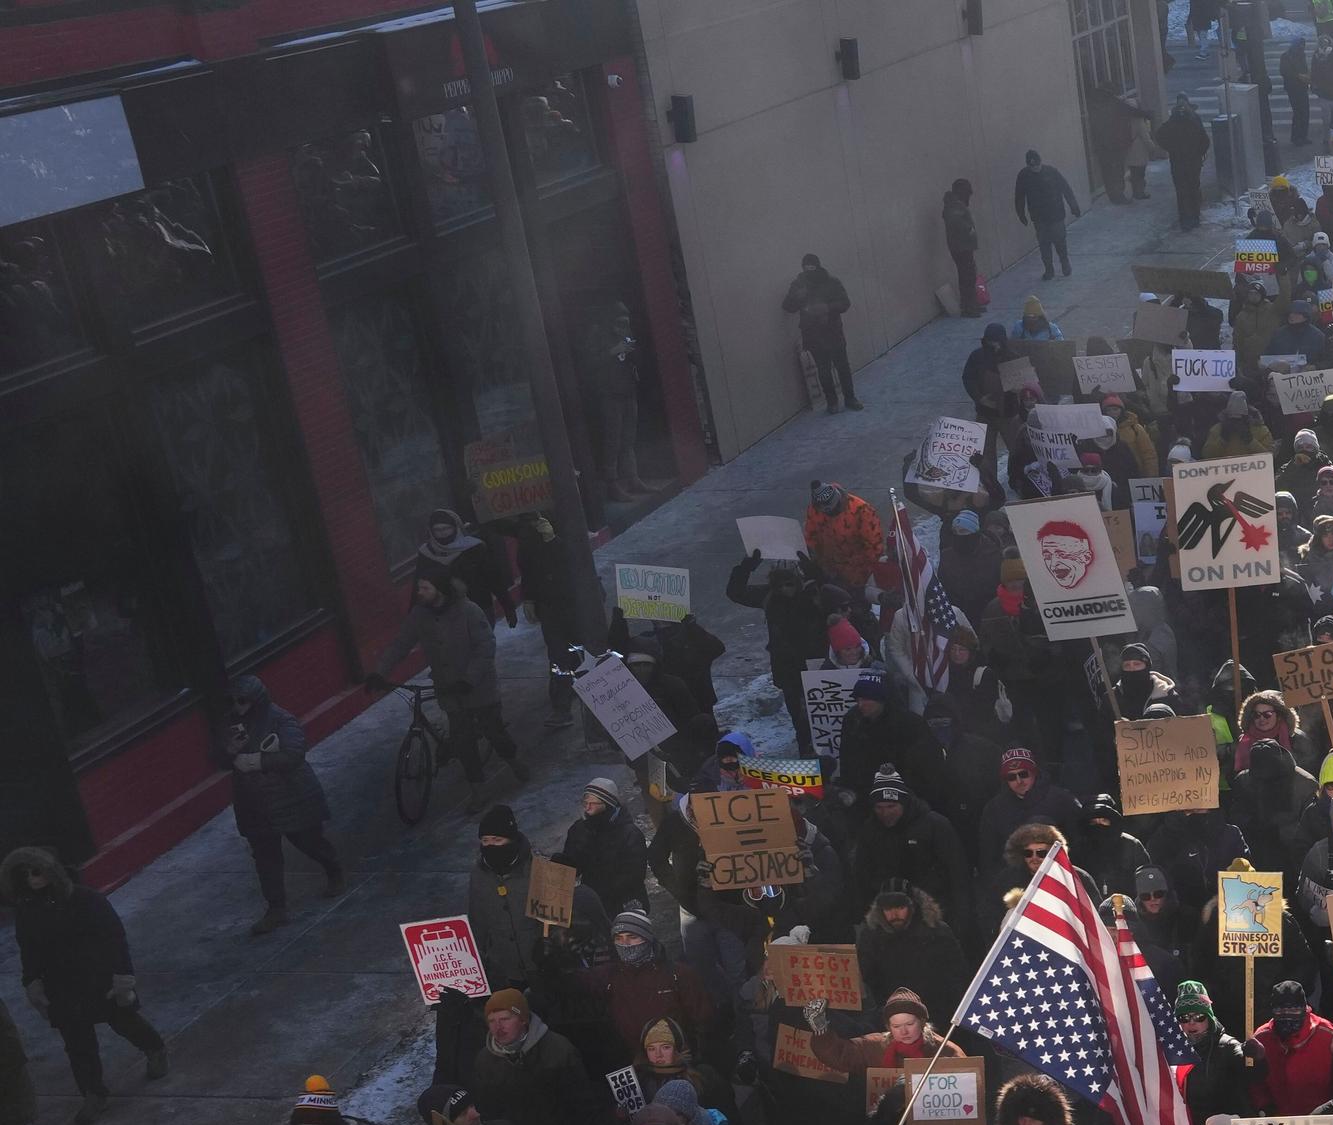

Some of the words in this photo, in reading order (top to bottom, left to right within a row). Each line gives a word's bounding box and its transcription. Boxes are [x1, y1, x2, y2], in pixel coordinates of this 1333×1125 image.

[1236, 253, 1252, 263] ICE
[1255, 253, 1278, 263] OUT
[1244, 263, 1270, 272] MSP
[1219, 460, 1267, 475] TREAD
[1188, 564, 1226, 584] ON
[1231, 560, 1273, 578] MN
[1043, 599, 1127, 620] COWARDICE
[705, 793, 781, 826] ICE
[1222, 932, 1280, 942] MINNESOTA
